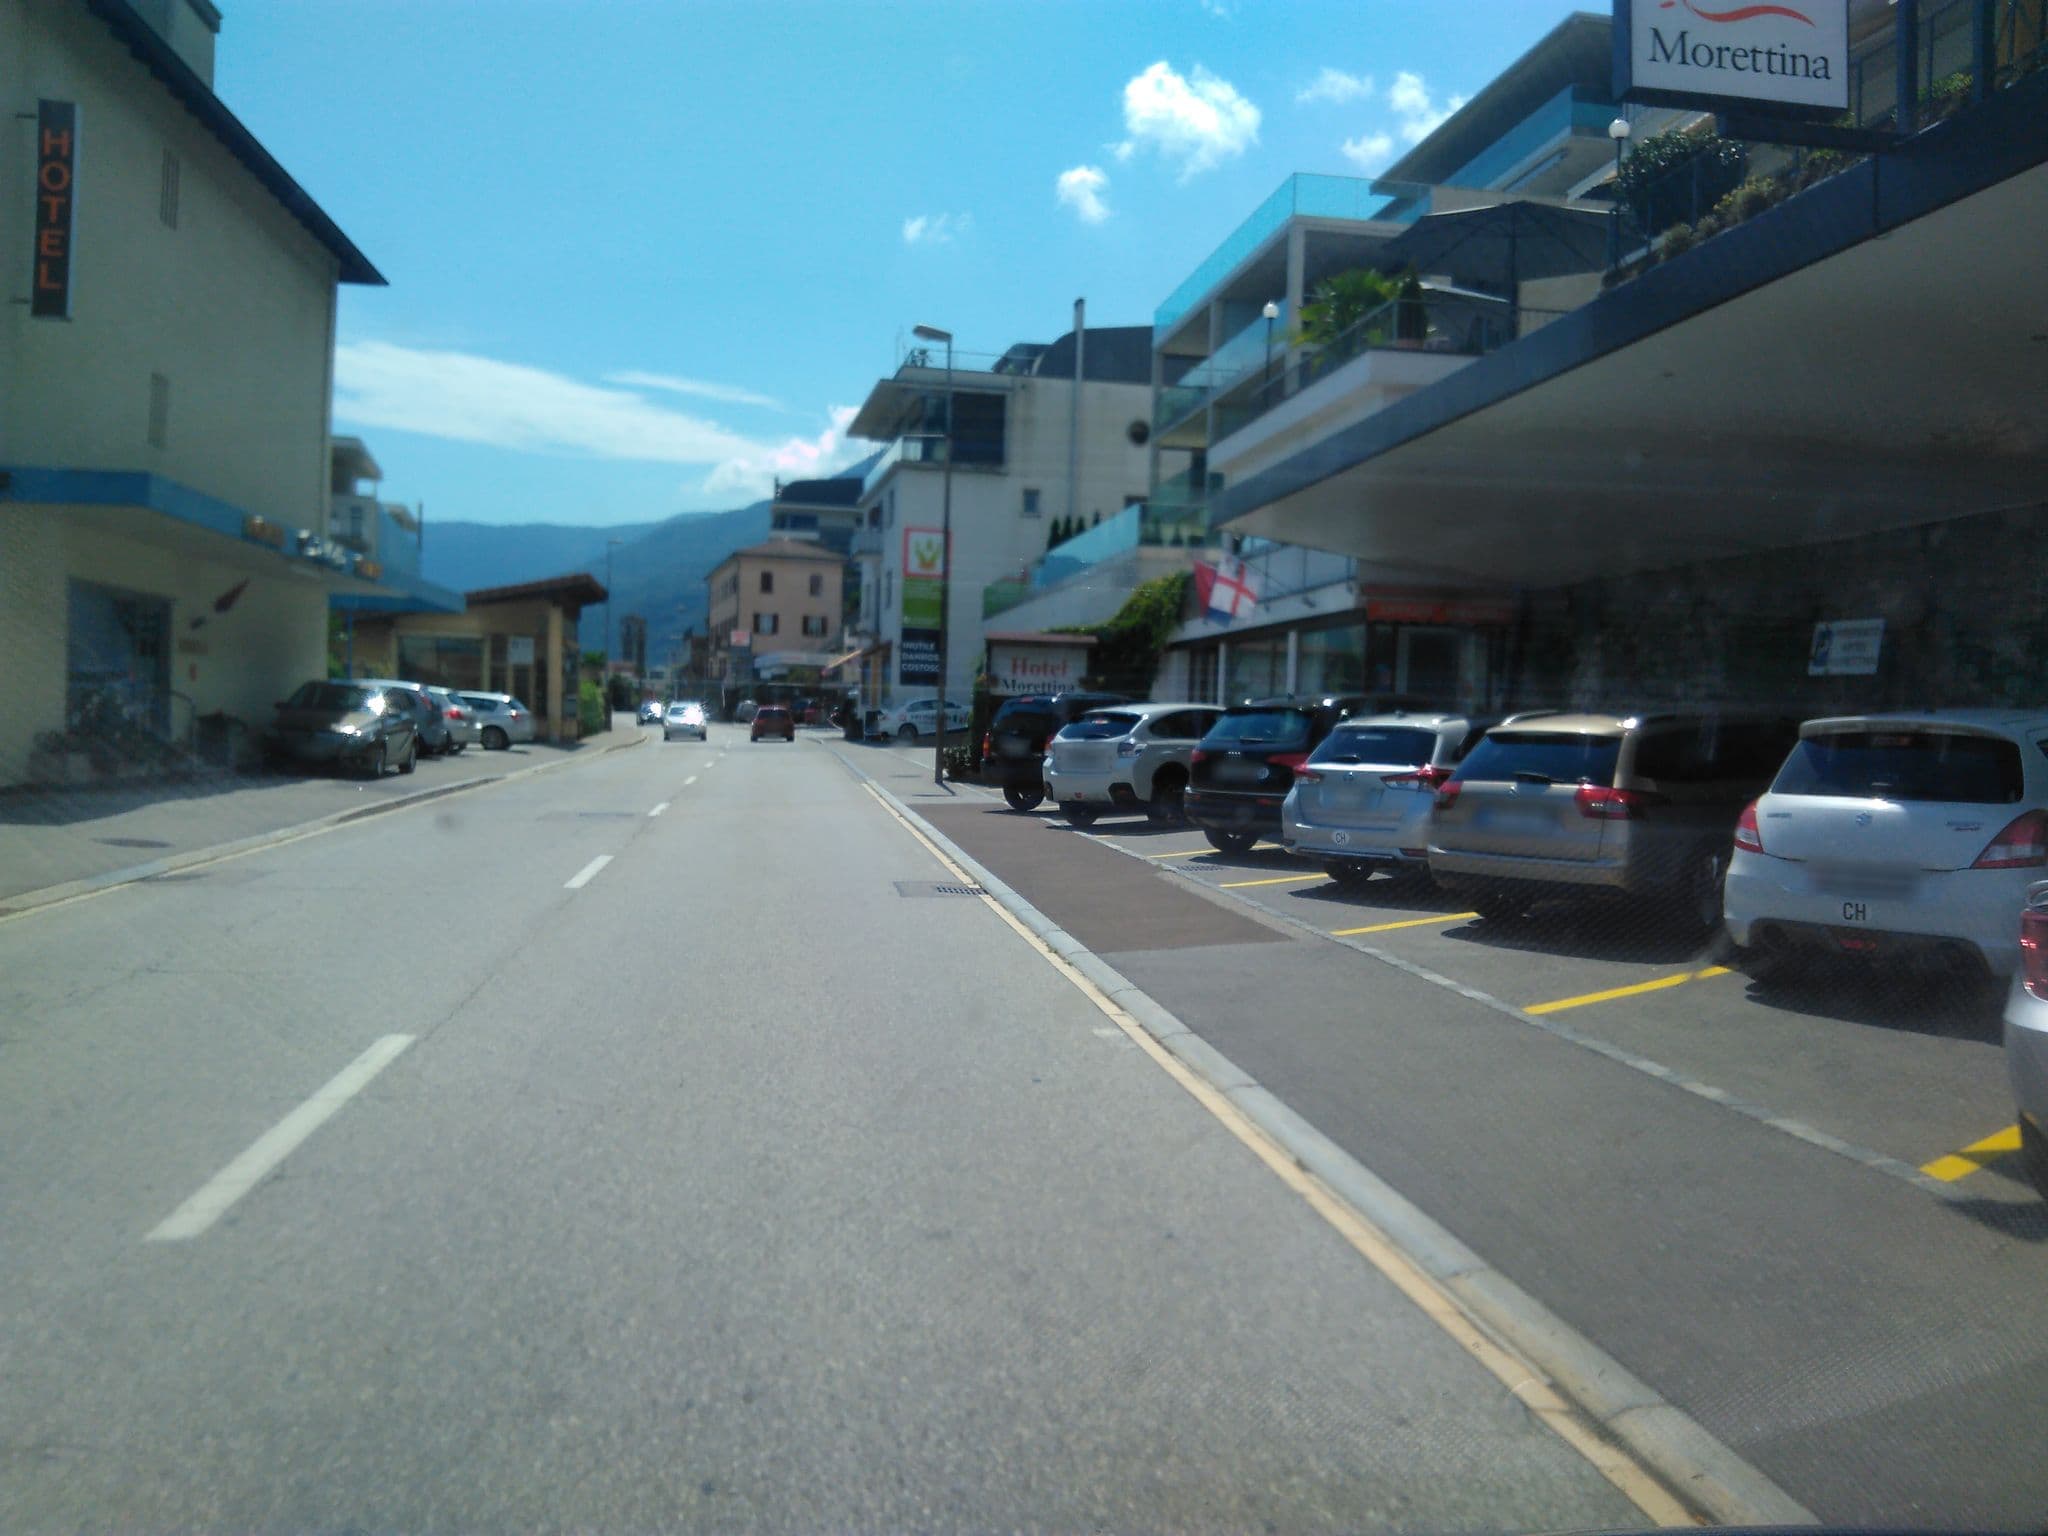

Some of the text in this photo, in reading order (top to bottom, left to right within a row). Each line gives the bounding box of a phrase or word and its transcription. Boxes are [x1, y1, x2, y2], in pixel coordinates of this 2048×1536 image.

[1648, 27, 1831, 80] Morettina
[39, 128, 71, 290] HOTEL
[1011, 656, 1068, 677] Hotel
[1001, 679, 1075, 694] Morettina
[1335, 831, 1346, 844] CH
[1843, 902, 1866, 920] CH
